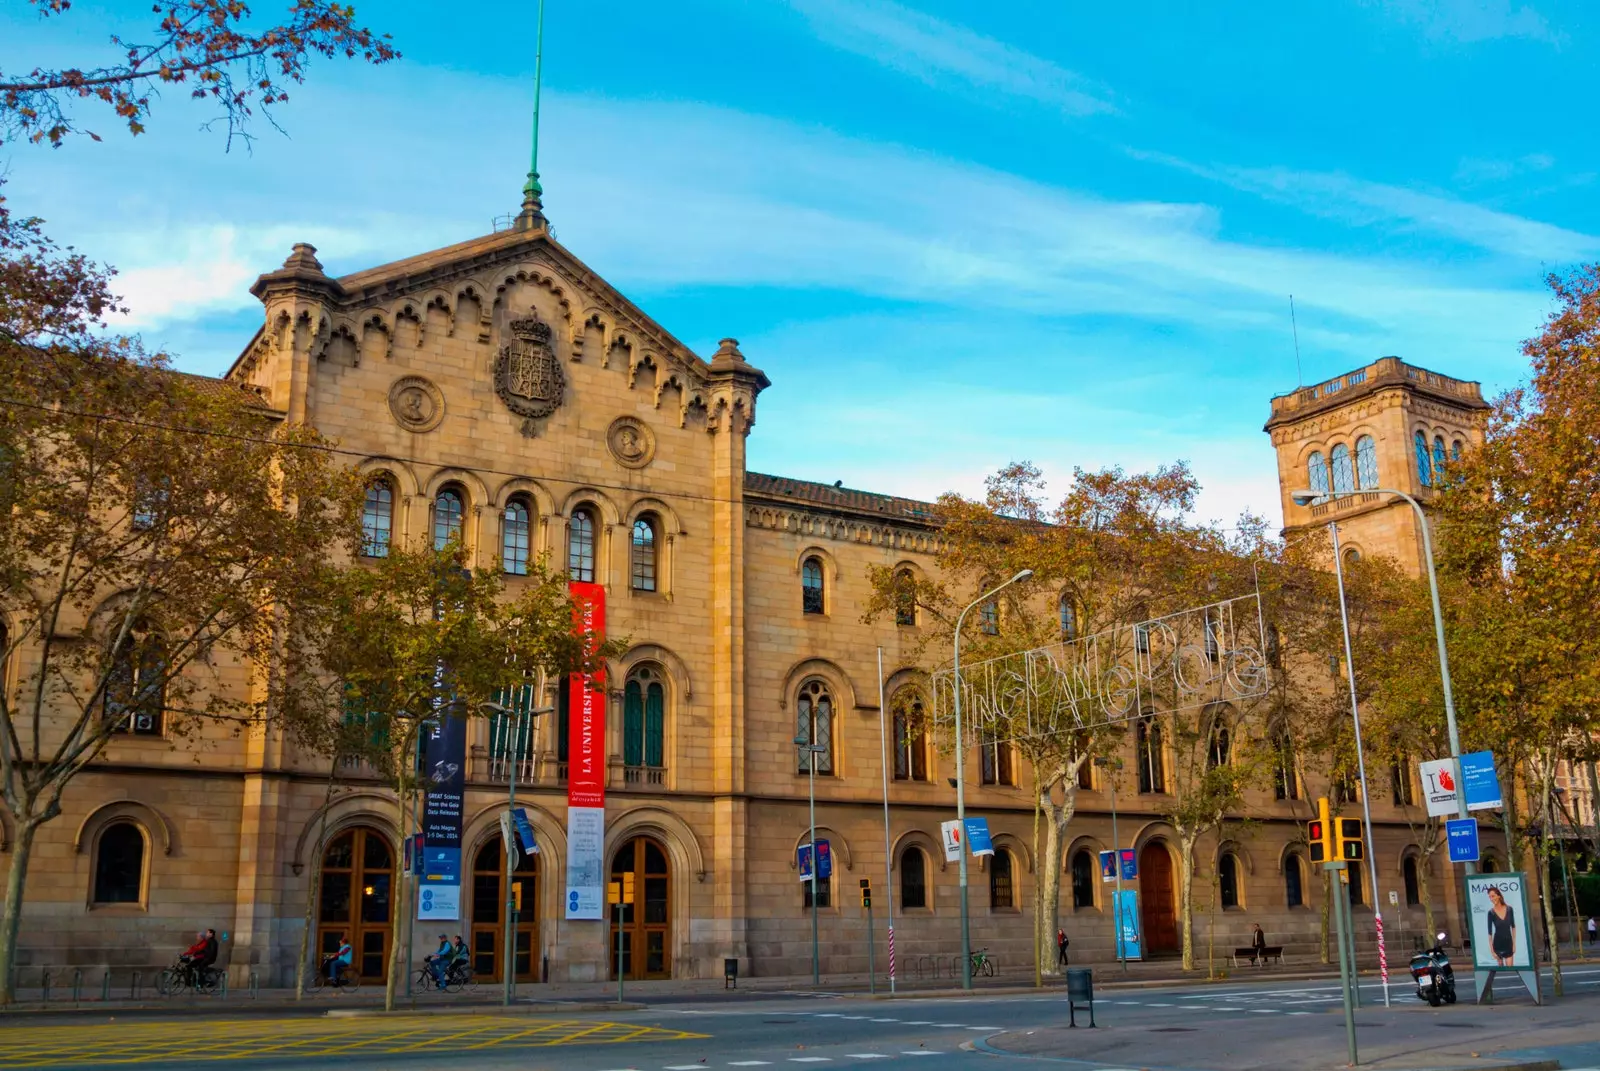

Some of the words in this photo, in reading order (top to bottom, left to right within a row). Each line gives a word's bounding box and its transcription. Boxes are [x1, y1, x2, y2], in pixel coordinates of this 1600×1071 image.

[582, 757, 592, 774] LA
[428, 792, 443, 800] GREAT
[1471, 881, 1519, 894] MANGO
